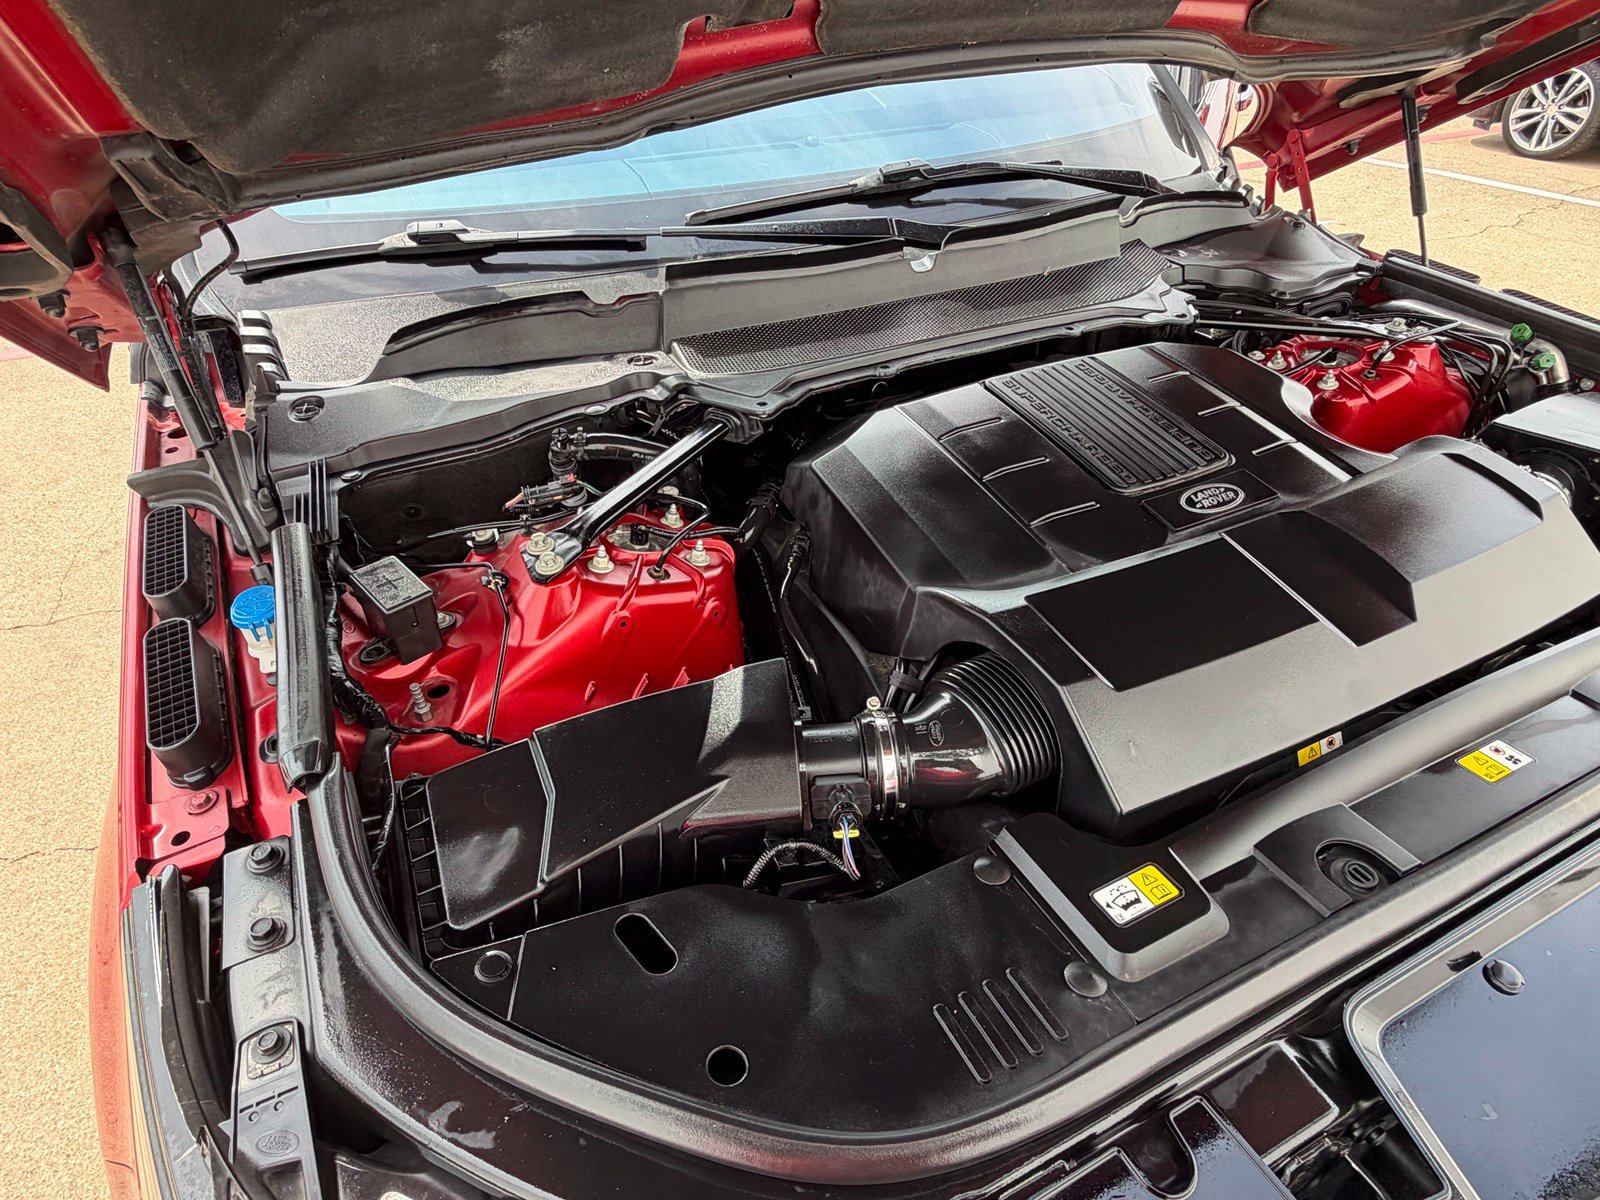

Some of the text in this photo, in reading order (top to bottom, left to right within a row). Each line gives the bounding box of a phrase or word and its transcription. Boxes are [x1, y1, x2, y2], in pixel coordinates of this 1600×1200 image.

[1002, 379, 1136, 483] SUPERCHARGED
[1074, 362, 1215, 460] SUPERCHARGED
[1190, 487, 1220, 503] LAND
[1201, 491, 1237, 508] ROVER
